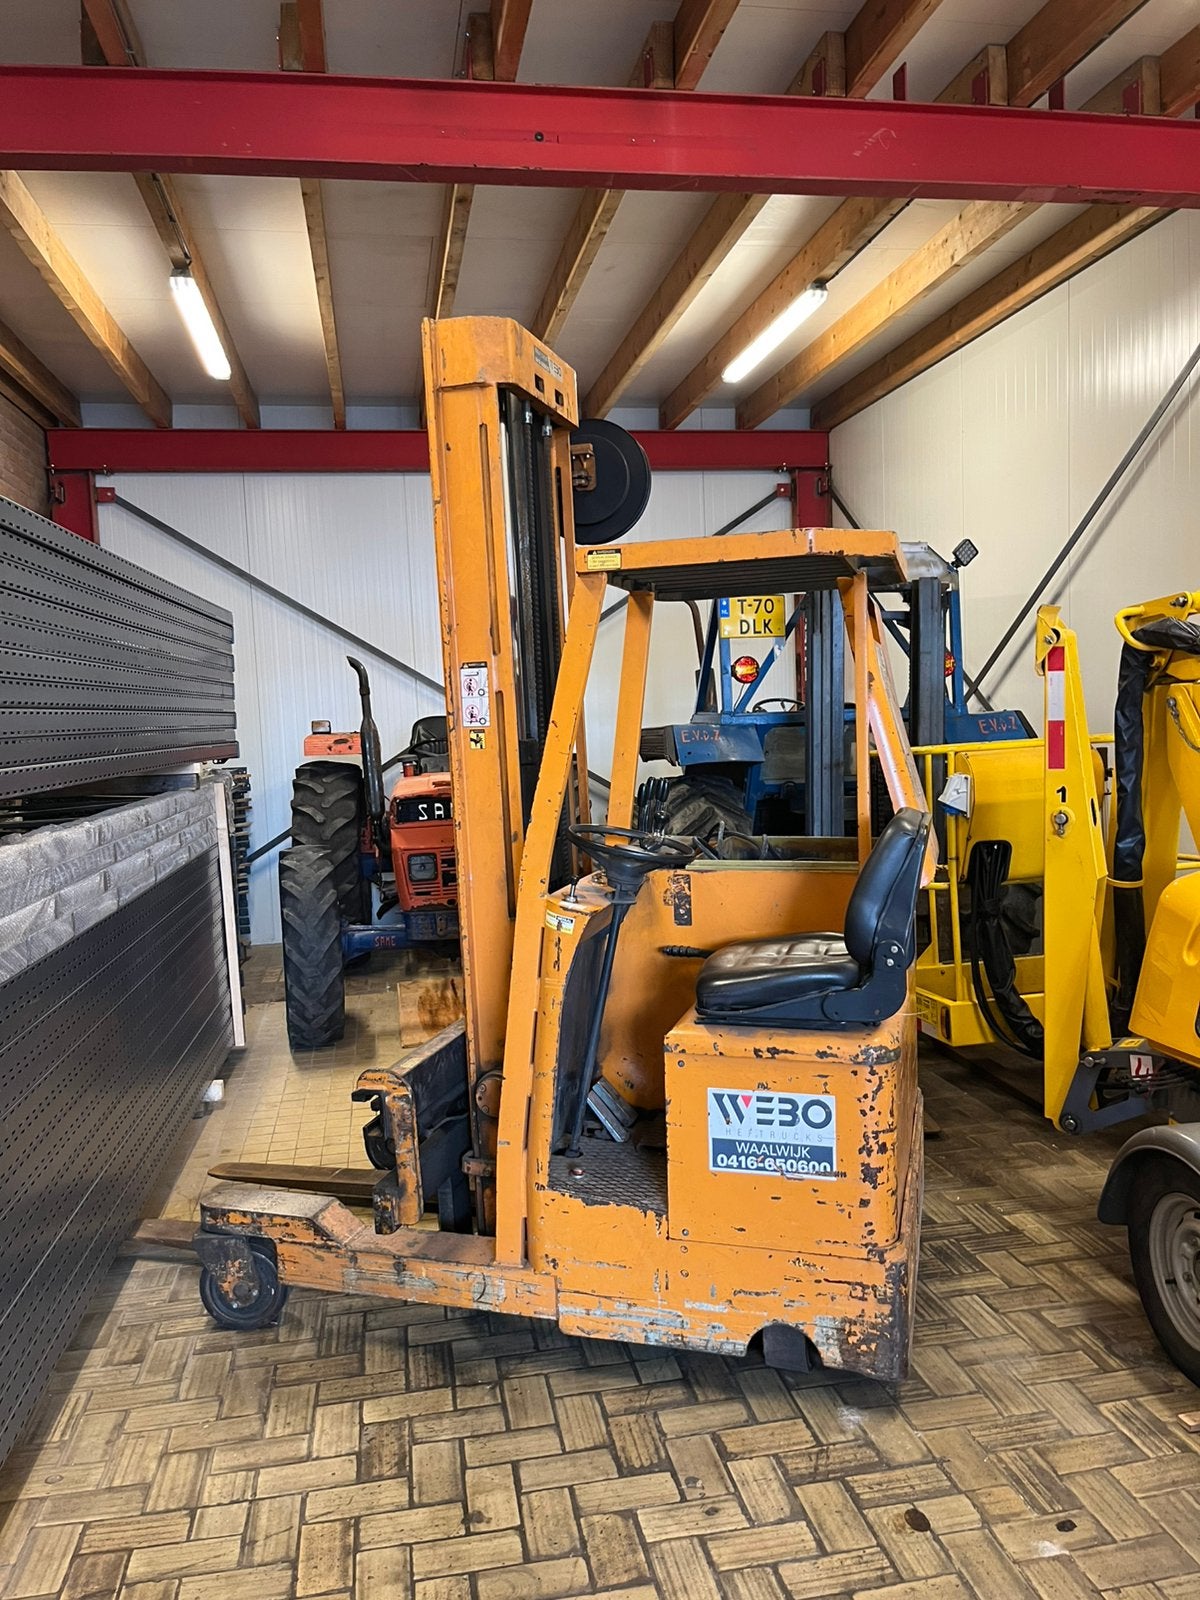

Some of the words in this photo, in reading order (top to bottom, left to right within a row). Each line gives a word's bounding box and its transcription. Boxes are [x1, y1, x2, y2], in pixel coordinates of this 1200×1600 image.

[737, 598, 774, 614] T-70
[739, 618, 773, 634] DLK
[1056, 785, 1067, 803] 1
[418, 802, 453, 820] SA
[375, 935, 396, 946] SAME
[712, 1092, 833, 1129] WEBO
[725, 1127, 823, 1142] HEFTRUCKS
[735, 1141, 811, 1159] WAALWIJK
[716, 1153, 831, 1173] 0416-650600
